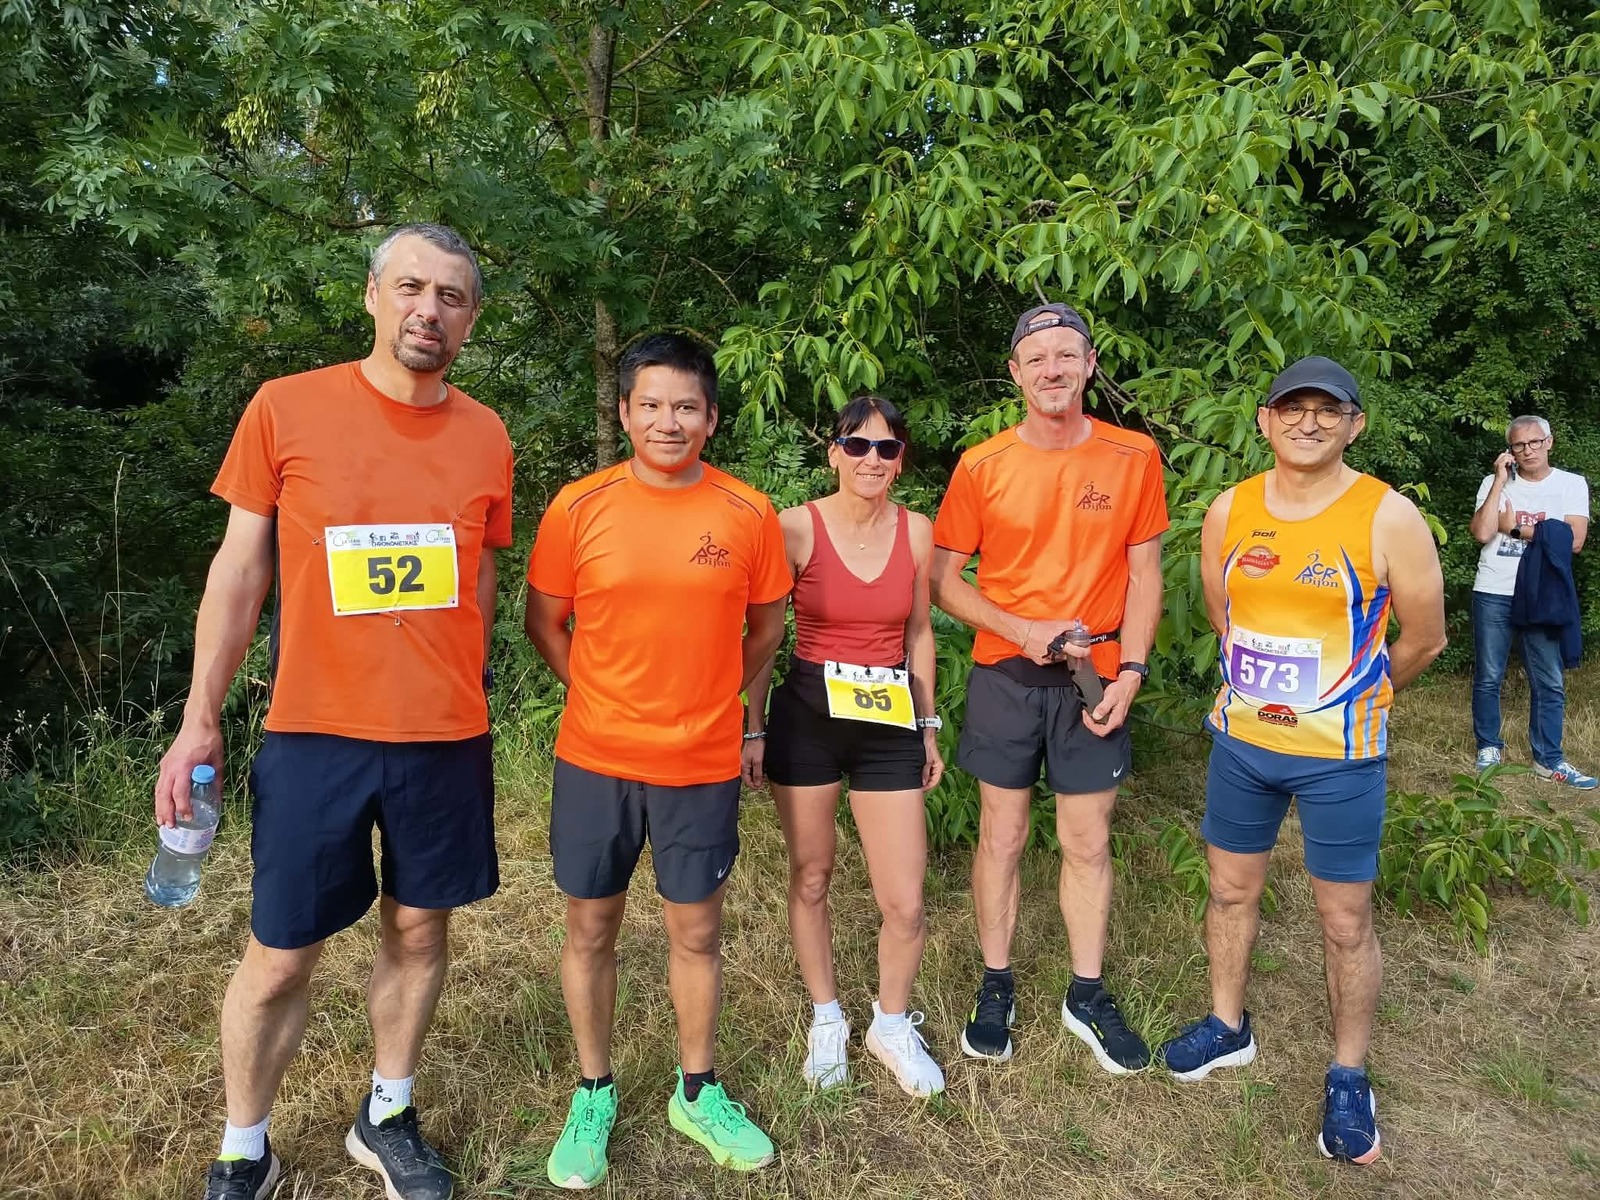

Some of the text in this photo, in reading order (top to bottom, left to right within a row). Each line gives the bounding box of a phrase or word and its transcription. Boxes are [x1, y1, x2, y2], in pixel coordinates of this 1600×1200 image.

[1076, 492, 1110, 508] ACR
[1082, 503, 1112, 511] Dijon
[689, 545, 729, 563] ACR
[697, 557, 731, 568] Dijon
[367, 555, 425, 595] 52
[1293, 563, 1338, 582] ACR
[1301, 576, 1339, 588] Dijon
[1240, 654, 1300, 693] 573
[852, 687, 892, 712] 85
[1257, 710, 1299, 723] DORAS
